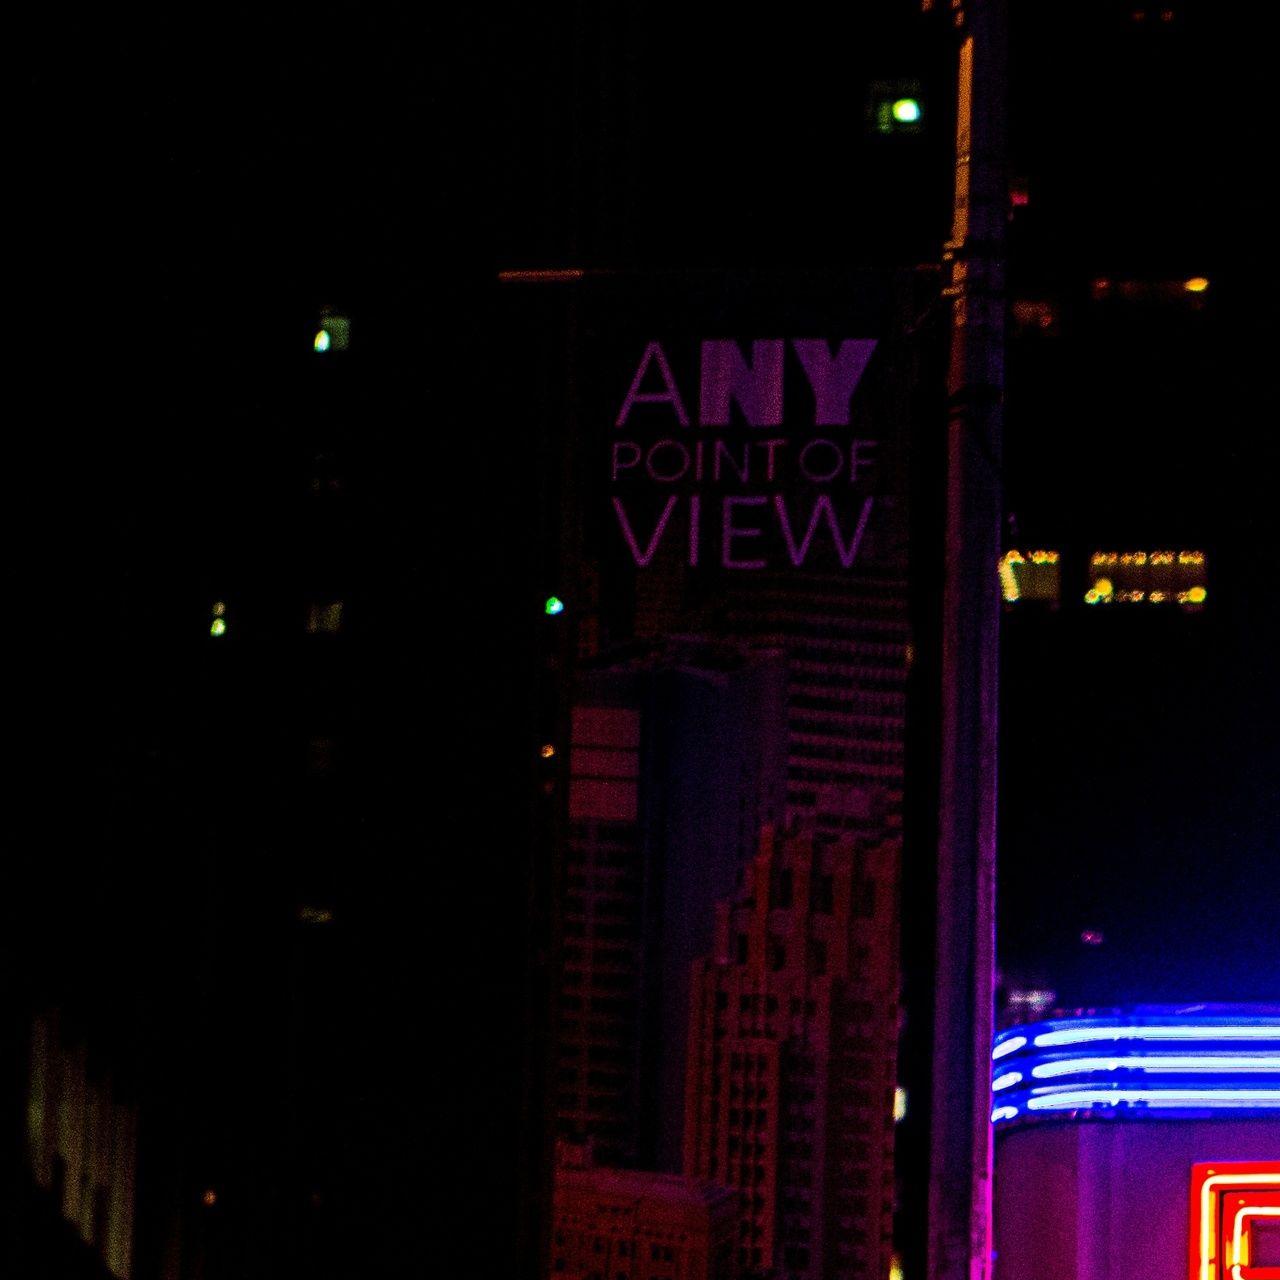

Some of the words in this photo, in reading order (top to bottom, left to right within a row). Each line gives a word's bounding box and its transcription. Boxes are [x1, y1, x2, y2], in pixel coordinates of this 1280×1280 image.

[613, 336, 880, 428] ANY
[610, 437, 790, 485] POINT
[799, 437, 880, 485] OF
[610, 492, 876, 569] VIEW
